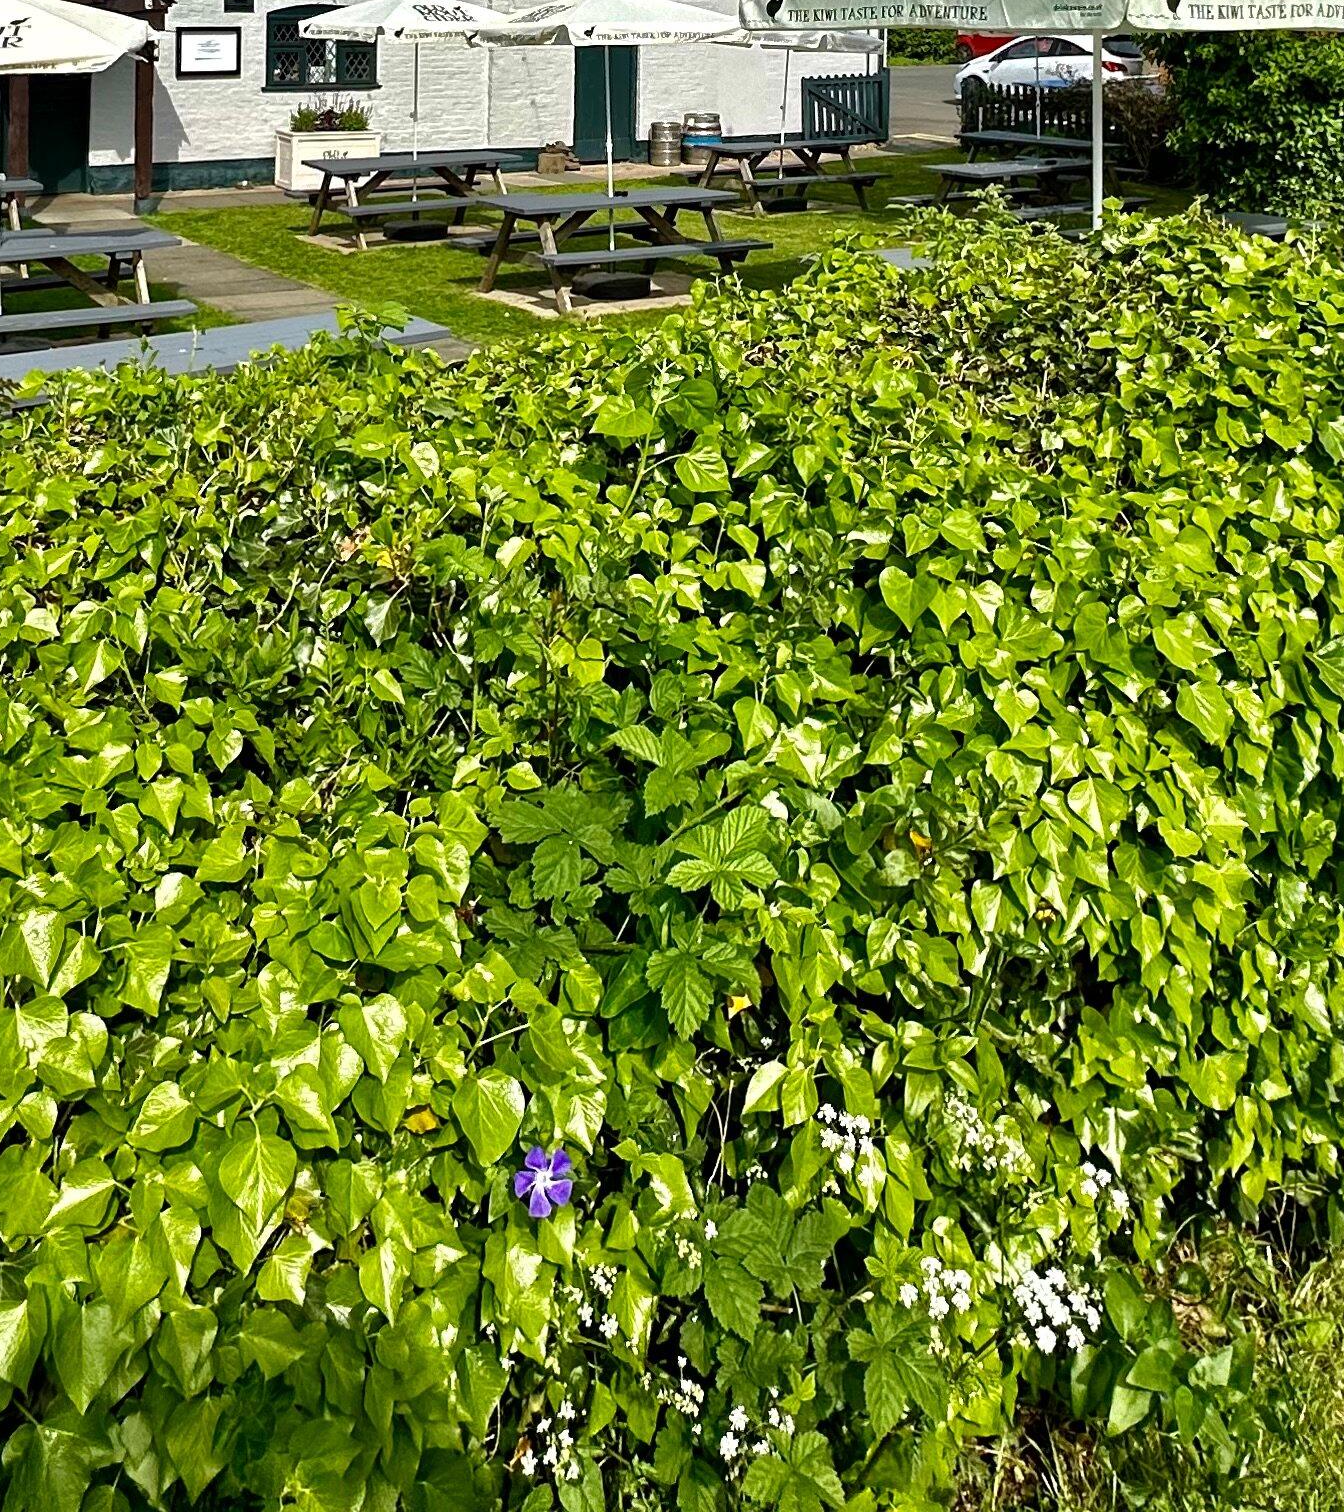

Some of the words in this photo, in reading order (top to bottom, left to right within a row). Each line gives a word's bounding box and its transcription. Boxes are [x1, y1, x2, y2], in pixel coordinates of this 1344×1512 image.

[787, 8, 810, 23] THE
[813, 7, 837, 22] KIWI
[841, 5, 878, 21] TASTE
[881, 4, 905, 19] FOR
[909, 3, 988, 22] ADVENTURE
[1187, 3, 1215, 20] THE
[1217, 4, 1245, 20] KIWI
[1248, 3, 1287, 20] TASTE
[1290, 2, 1314, 18] FOR
